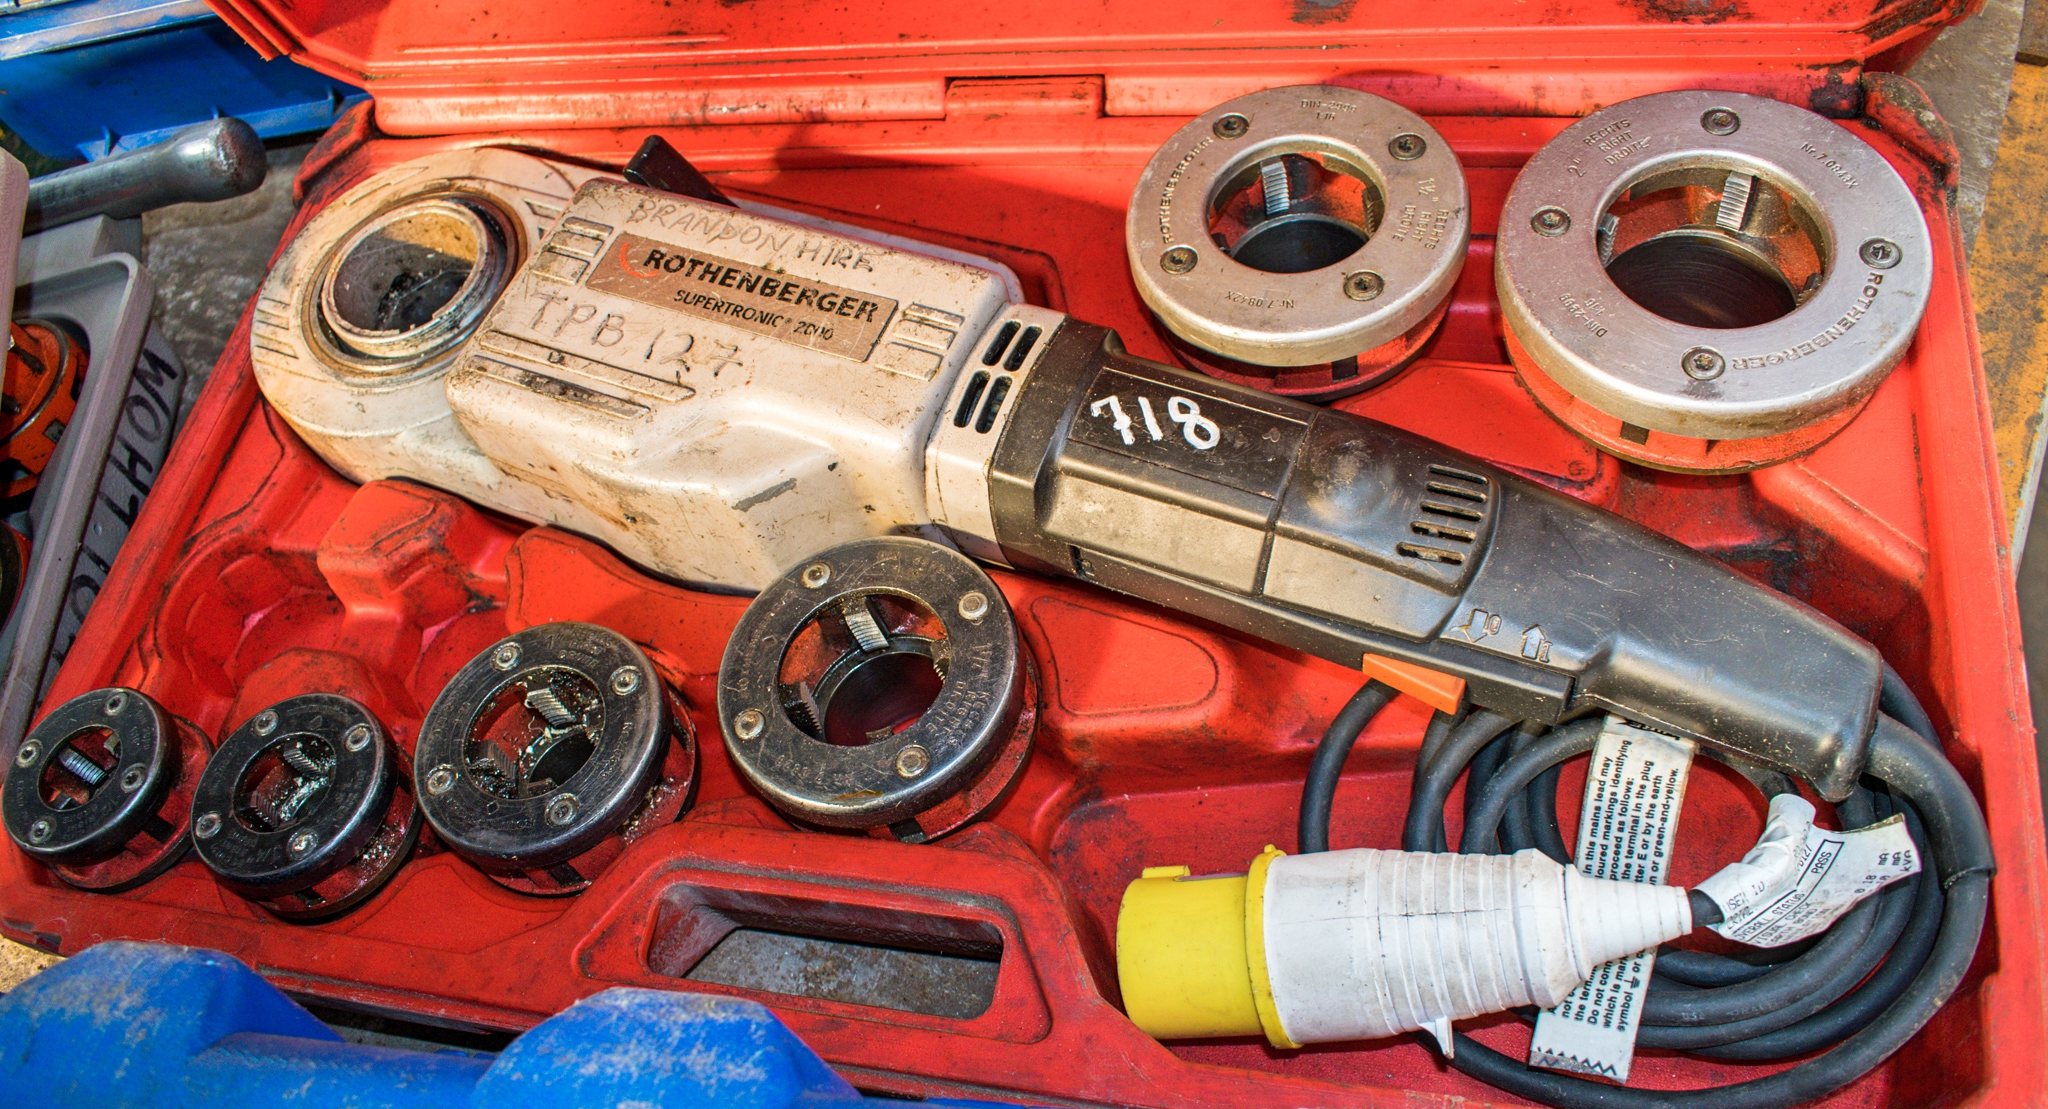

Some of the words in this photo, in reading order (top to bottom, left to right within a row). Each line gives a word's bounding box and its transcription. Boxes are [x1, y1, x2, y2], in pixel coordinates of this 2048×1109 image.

[627, 197, 792, 255] BRANDON
[642, 247, 879, 325] ROTHENBERGER
[529, 292, 627, 348] TPB
[1731, 271, 1884, 371] ROTHENBERGER
[1087, 394, 1222, 451] 718
[1601, 757, 1613, 777] may
[1640, 760, 1655, 783] plug
[1594, 780, 1606, 801] lead
[1602, 791, 1618, 841] markings
[1611, 740, 1632, 788] identifying
[1618, 778, 1634, 817] follows:
[1635, 784, 1647, 800] the
[1651, 775, 1663, 800] earth
[1590, 805, 1602, 838] mains
[1645, 803, 1657, 819] the
[1617, 820, 1626, 833] as
[1625, 814, 1640, 859] terminal
[1642, 822, 1655, 835] by
[1585, 842, 1596, 862] this
[1642, 838, 1649, 850] or
[1610, 836, 1623, 882] proceed
[1621, 860, 1632, 880] the
[1652, 860, 1660, 872] or
[1810, 850, 1833, 875] PASS
[1562, 1000, 1572, 1018] not
[1587, 1009, 1599, 1025] Do
[1594, 988, 1605, 1006] not
[1617, 991, 1633, 1032] symbol
[1632, 962, 1641, 973] or
[1575, 1004, 1586, 1021] the
[1603, 996, 1617, 1028] which
